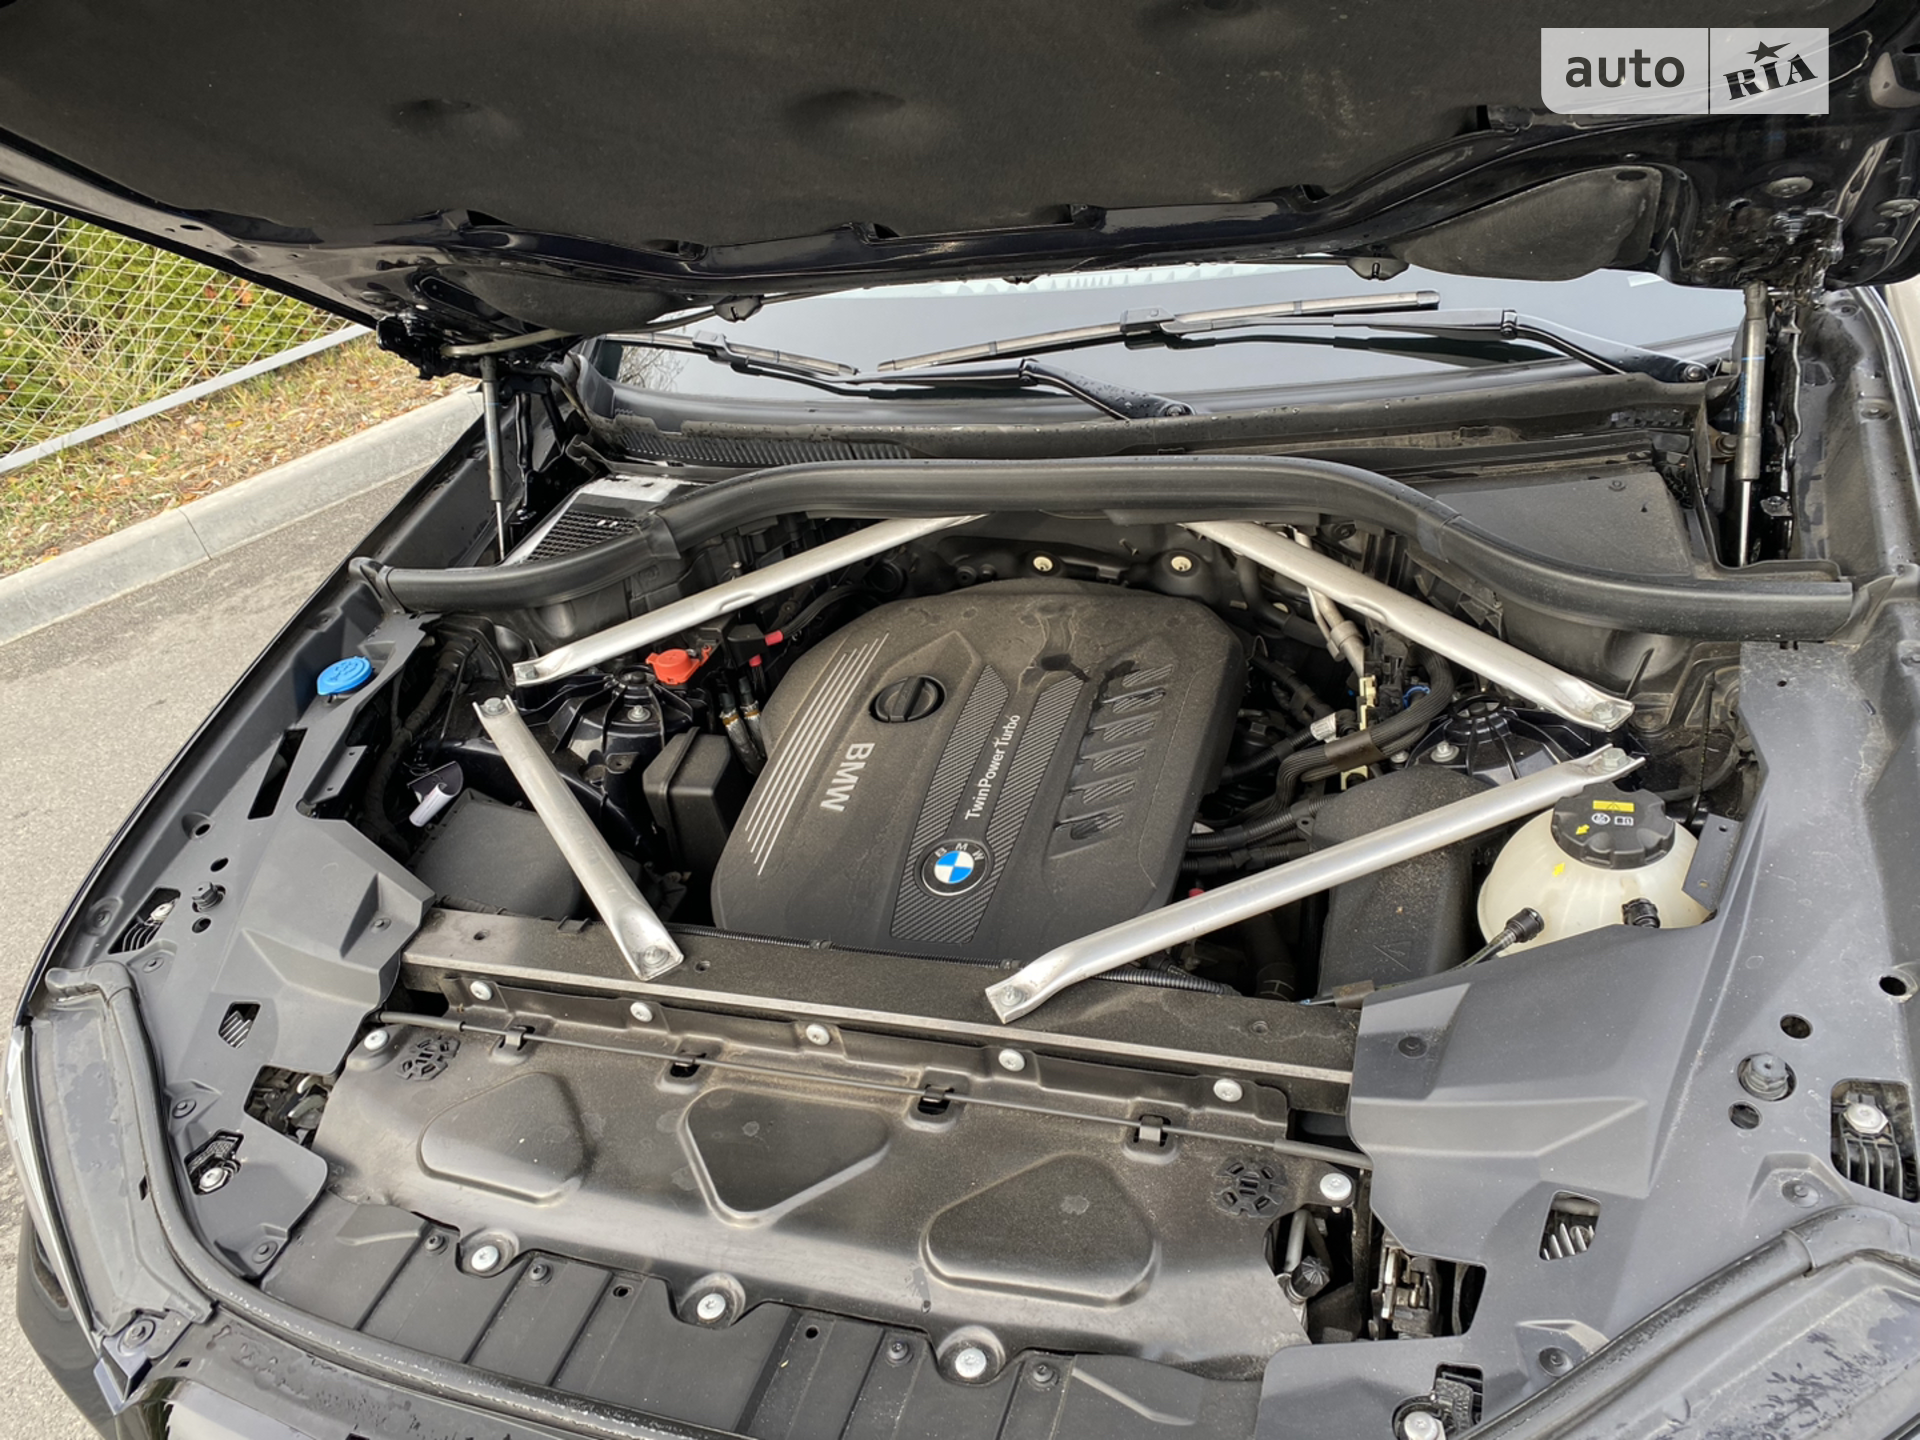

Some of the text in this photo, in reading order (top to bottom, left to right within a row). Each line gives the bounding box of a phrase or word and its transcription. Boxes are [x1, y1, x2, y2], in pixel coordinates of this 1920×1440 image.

[820, 742, 875, 812] BMW
[964, 715, 1021, 820] TwinPower Turbo
[934, 842, 985, 861] BMW
